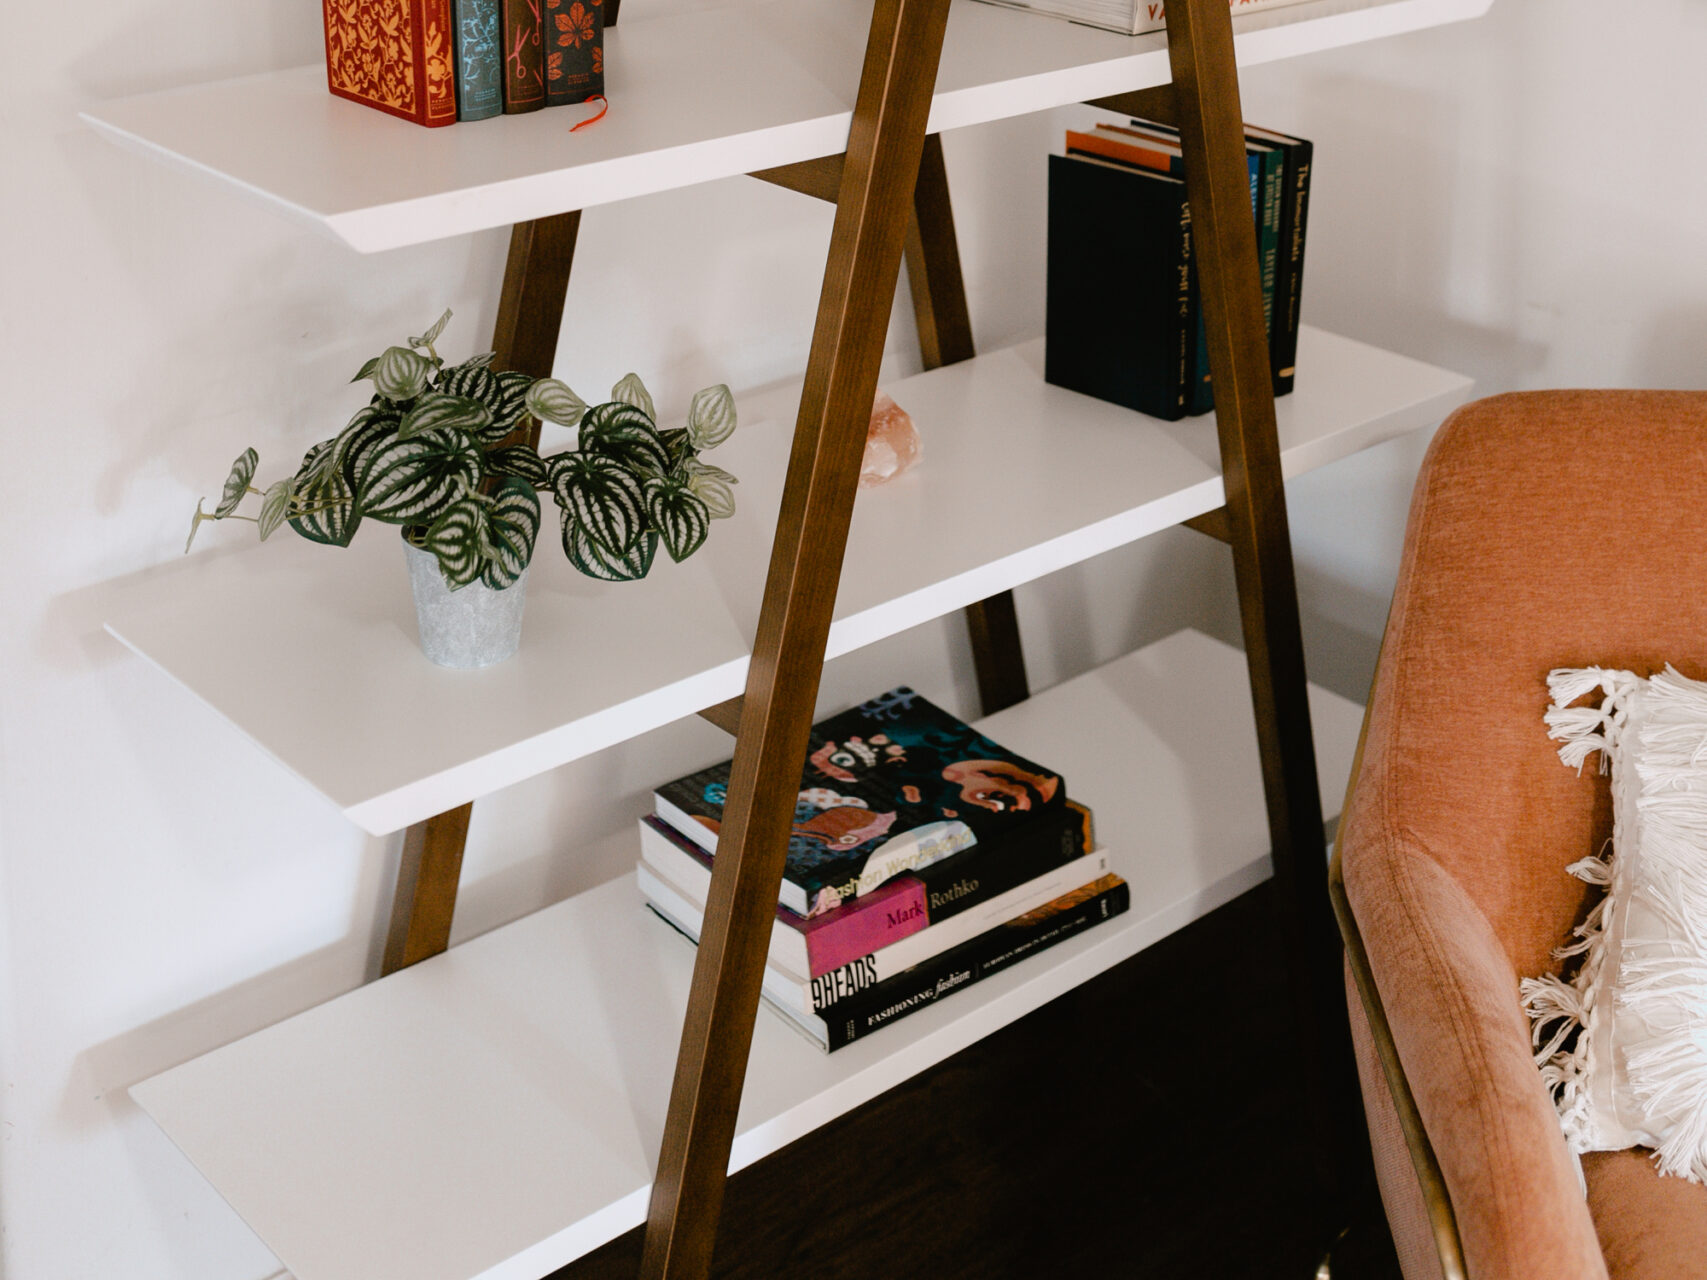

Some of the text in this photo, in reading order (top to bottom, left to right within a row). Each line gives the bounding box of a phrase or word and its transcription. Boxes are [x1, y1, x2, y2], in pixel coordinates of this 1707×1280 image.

[1296, 164, 1310, 188] The
[1291, 191, 1306, 262] Immortalists
[825, 826, 972, 905] Fashion Wonderland
[887, 900, 924, 928] Mark
[930, 879, 980, 909] Rothko
[867, 970, 971, 1026] FASHIONING fashion
